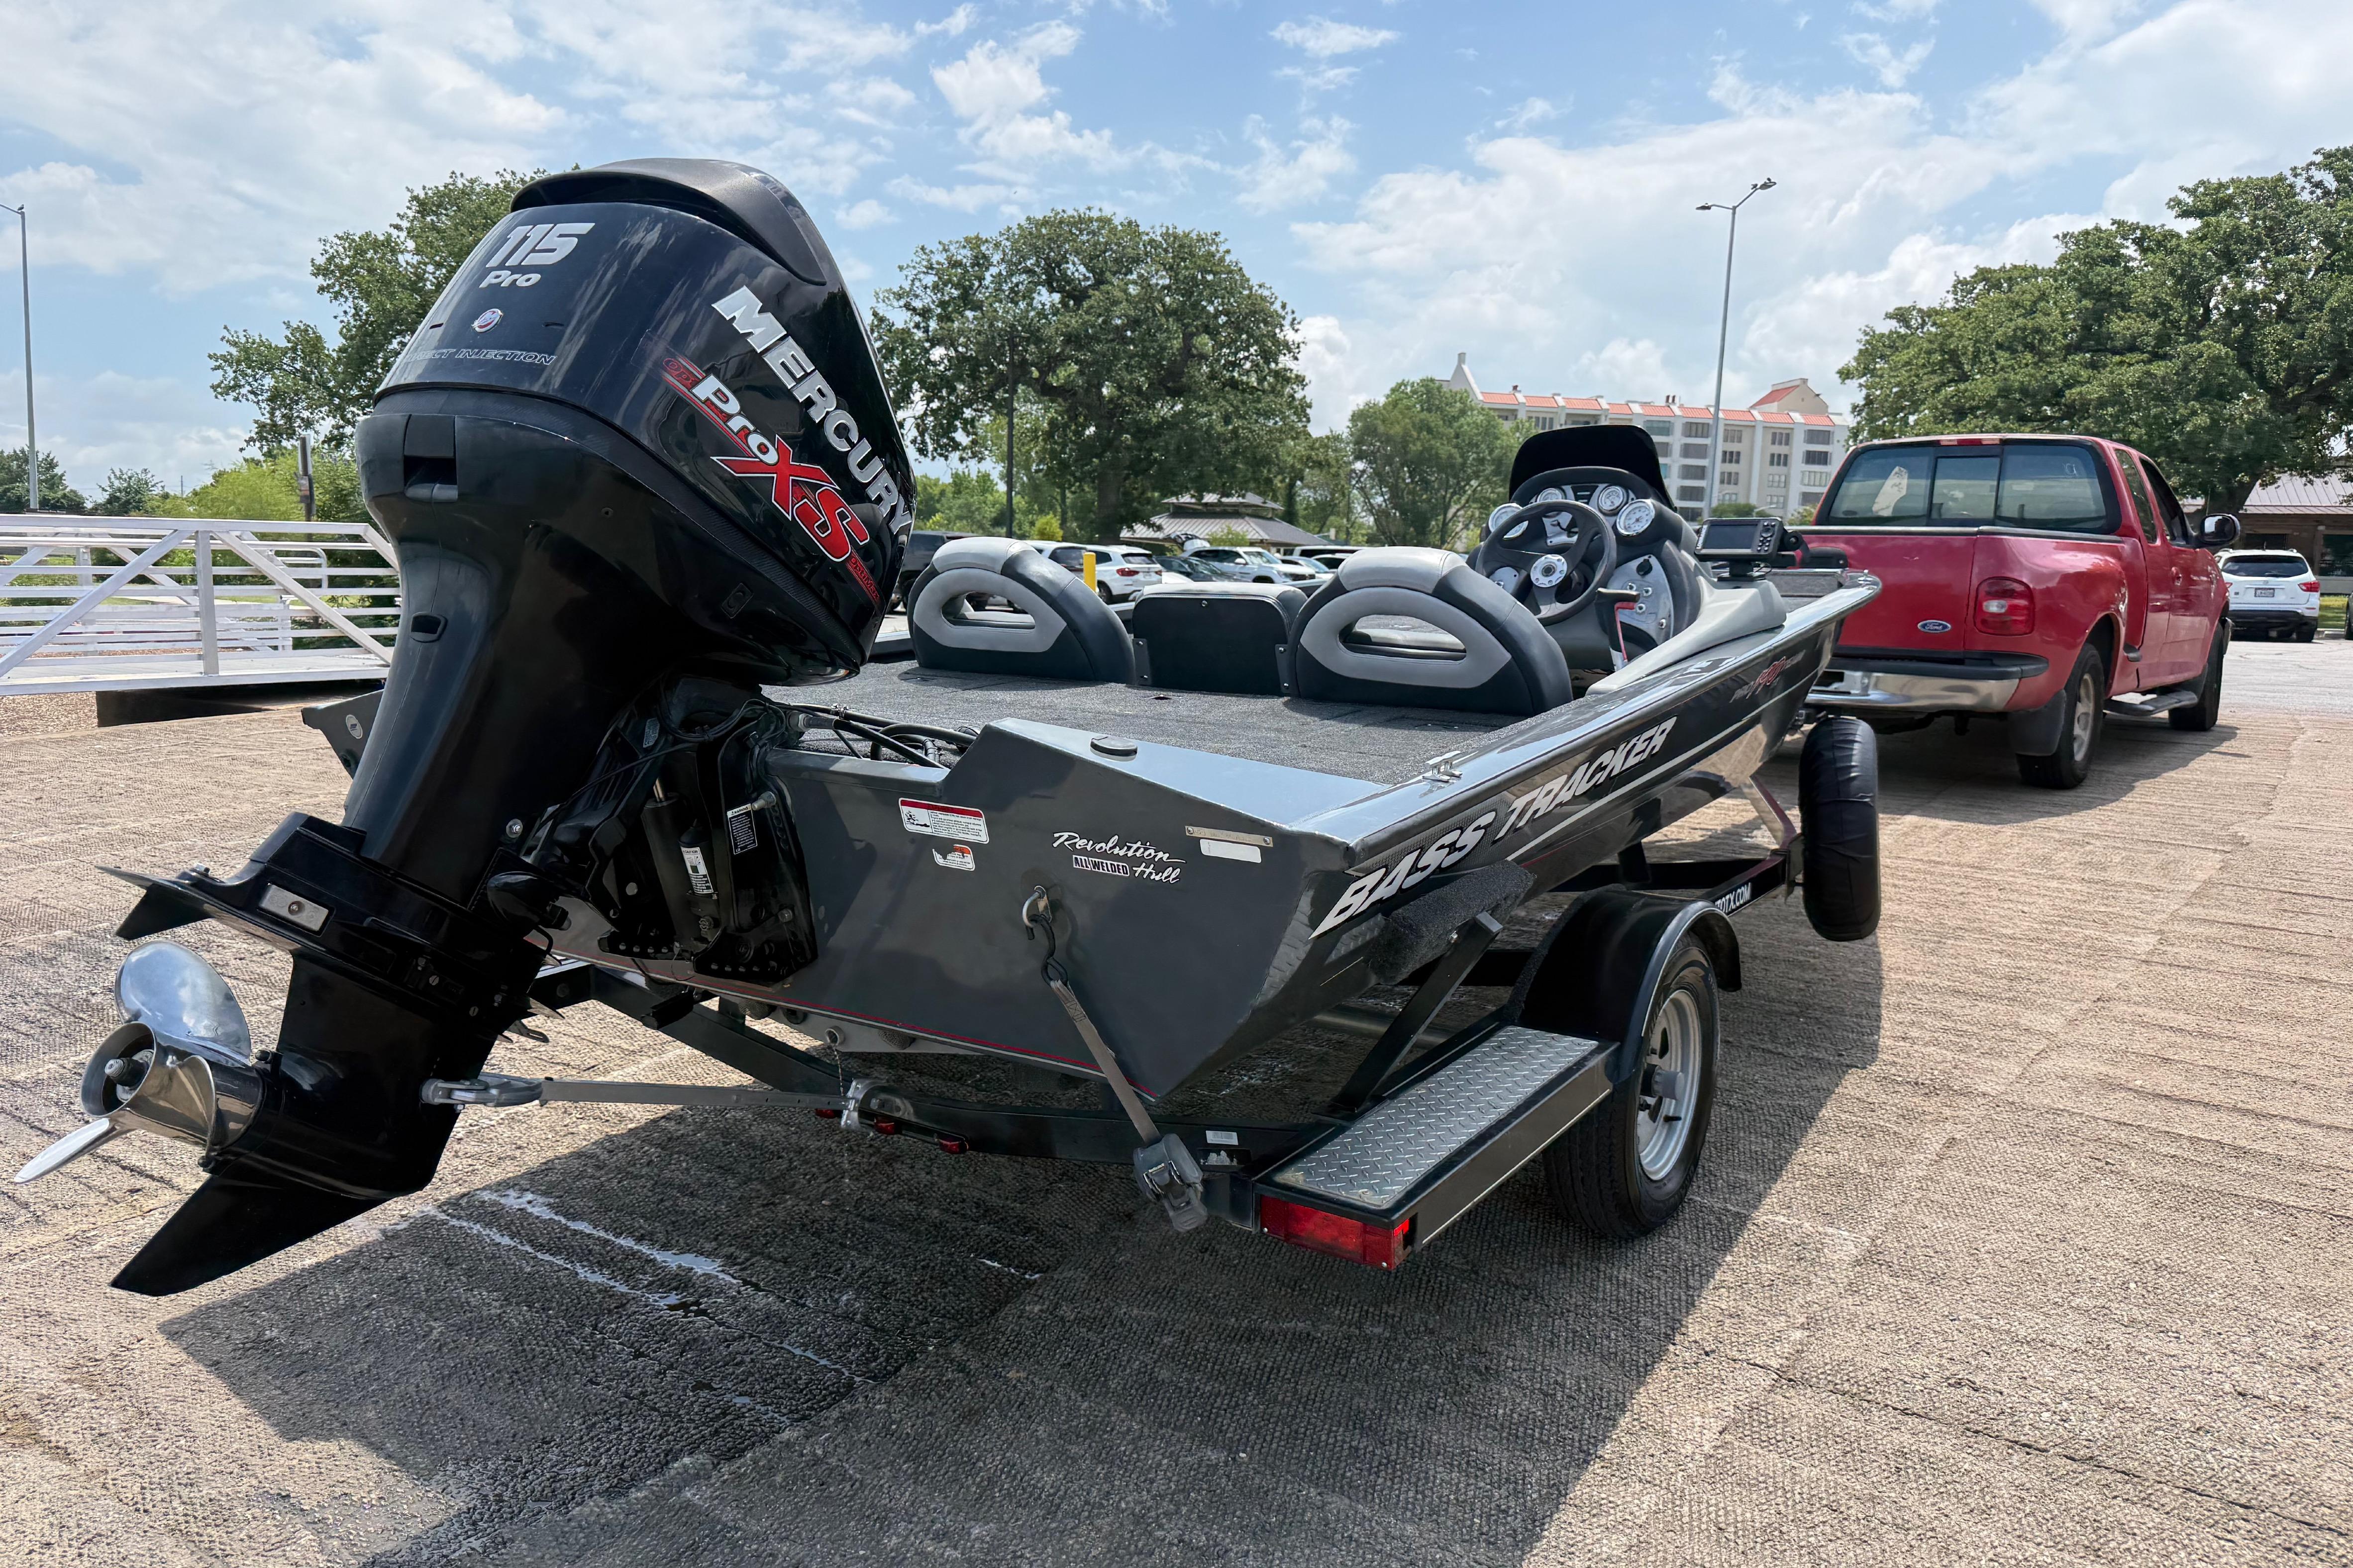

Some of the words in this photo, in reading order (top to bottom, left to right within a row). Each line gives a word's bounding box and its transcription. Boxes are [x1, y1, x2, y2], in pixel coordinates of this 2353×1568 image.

[486, 222, 596, 268] 115
[479, 270, 541, 289] Pro
[455, 349, 558, 365] INJECTION
[711, 285, 914, 535] MERCURY
[1309, 811, 1496, 940] BASS
[1495, 716, 1677, 841] TRACKER
[1052, 832, 1186, 863] Revolution
[1074, 857, 1091, 869] ALL
[1091, 859, 1129, 876] WELDED
[1132, 862, 1181, 883] Hull
